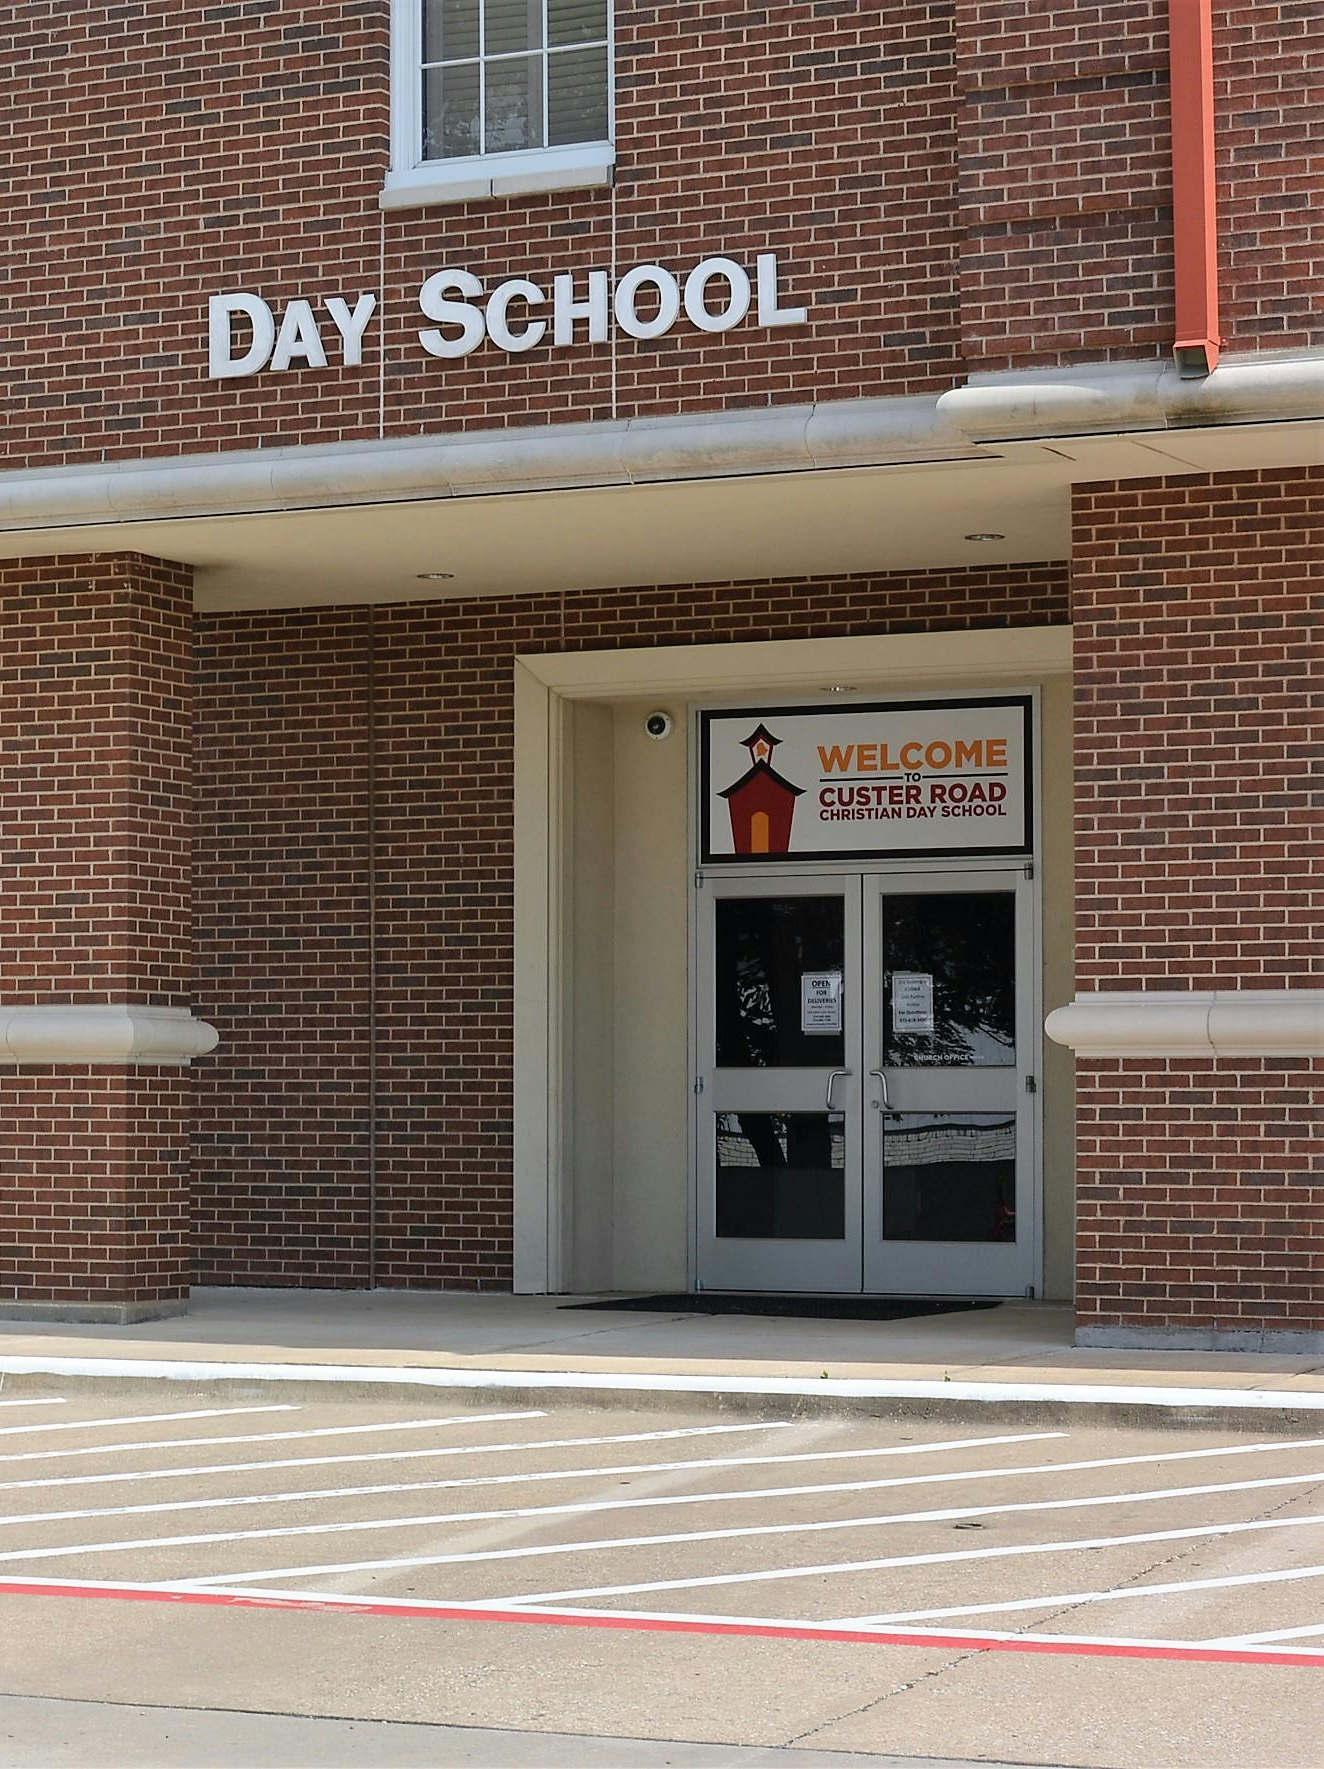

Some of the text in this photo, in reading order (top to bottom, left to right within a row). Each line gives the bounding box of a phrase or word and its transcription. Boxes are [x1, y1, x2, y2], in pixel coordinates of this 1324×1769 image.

[208, 253, 808, 380] DAY SCHOOL
[817, 738, 1008, 773] WELCOME
[904, 772, 922, 783] TO
[819, 782, 1008, 807] CUSTER ROAD
[819, 804, 1008, 821] CHRISTIAN DAY SCHOOL
